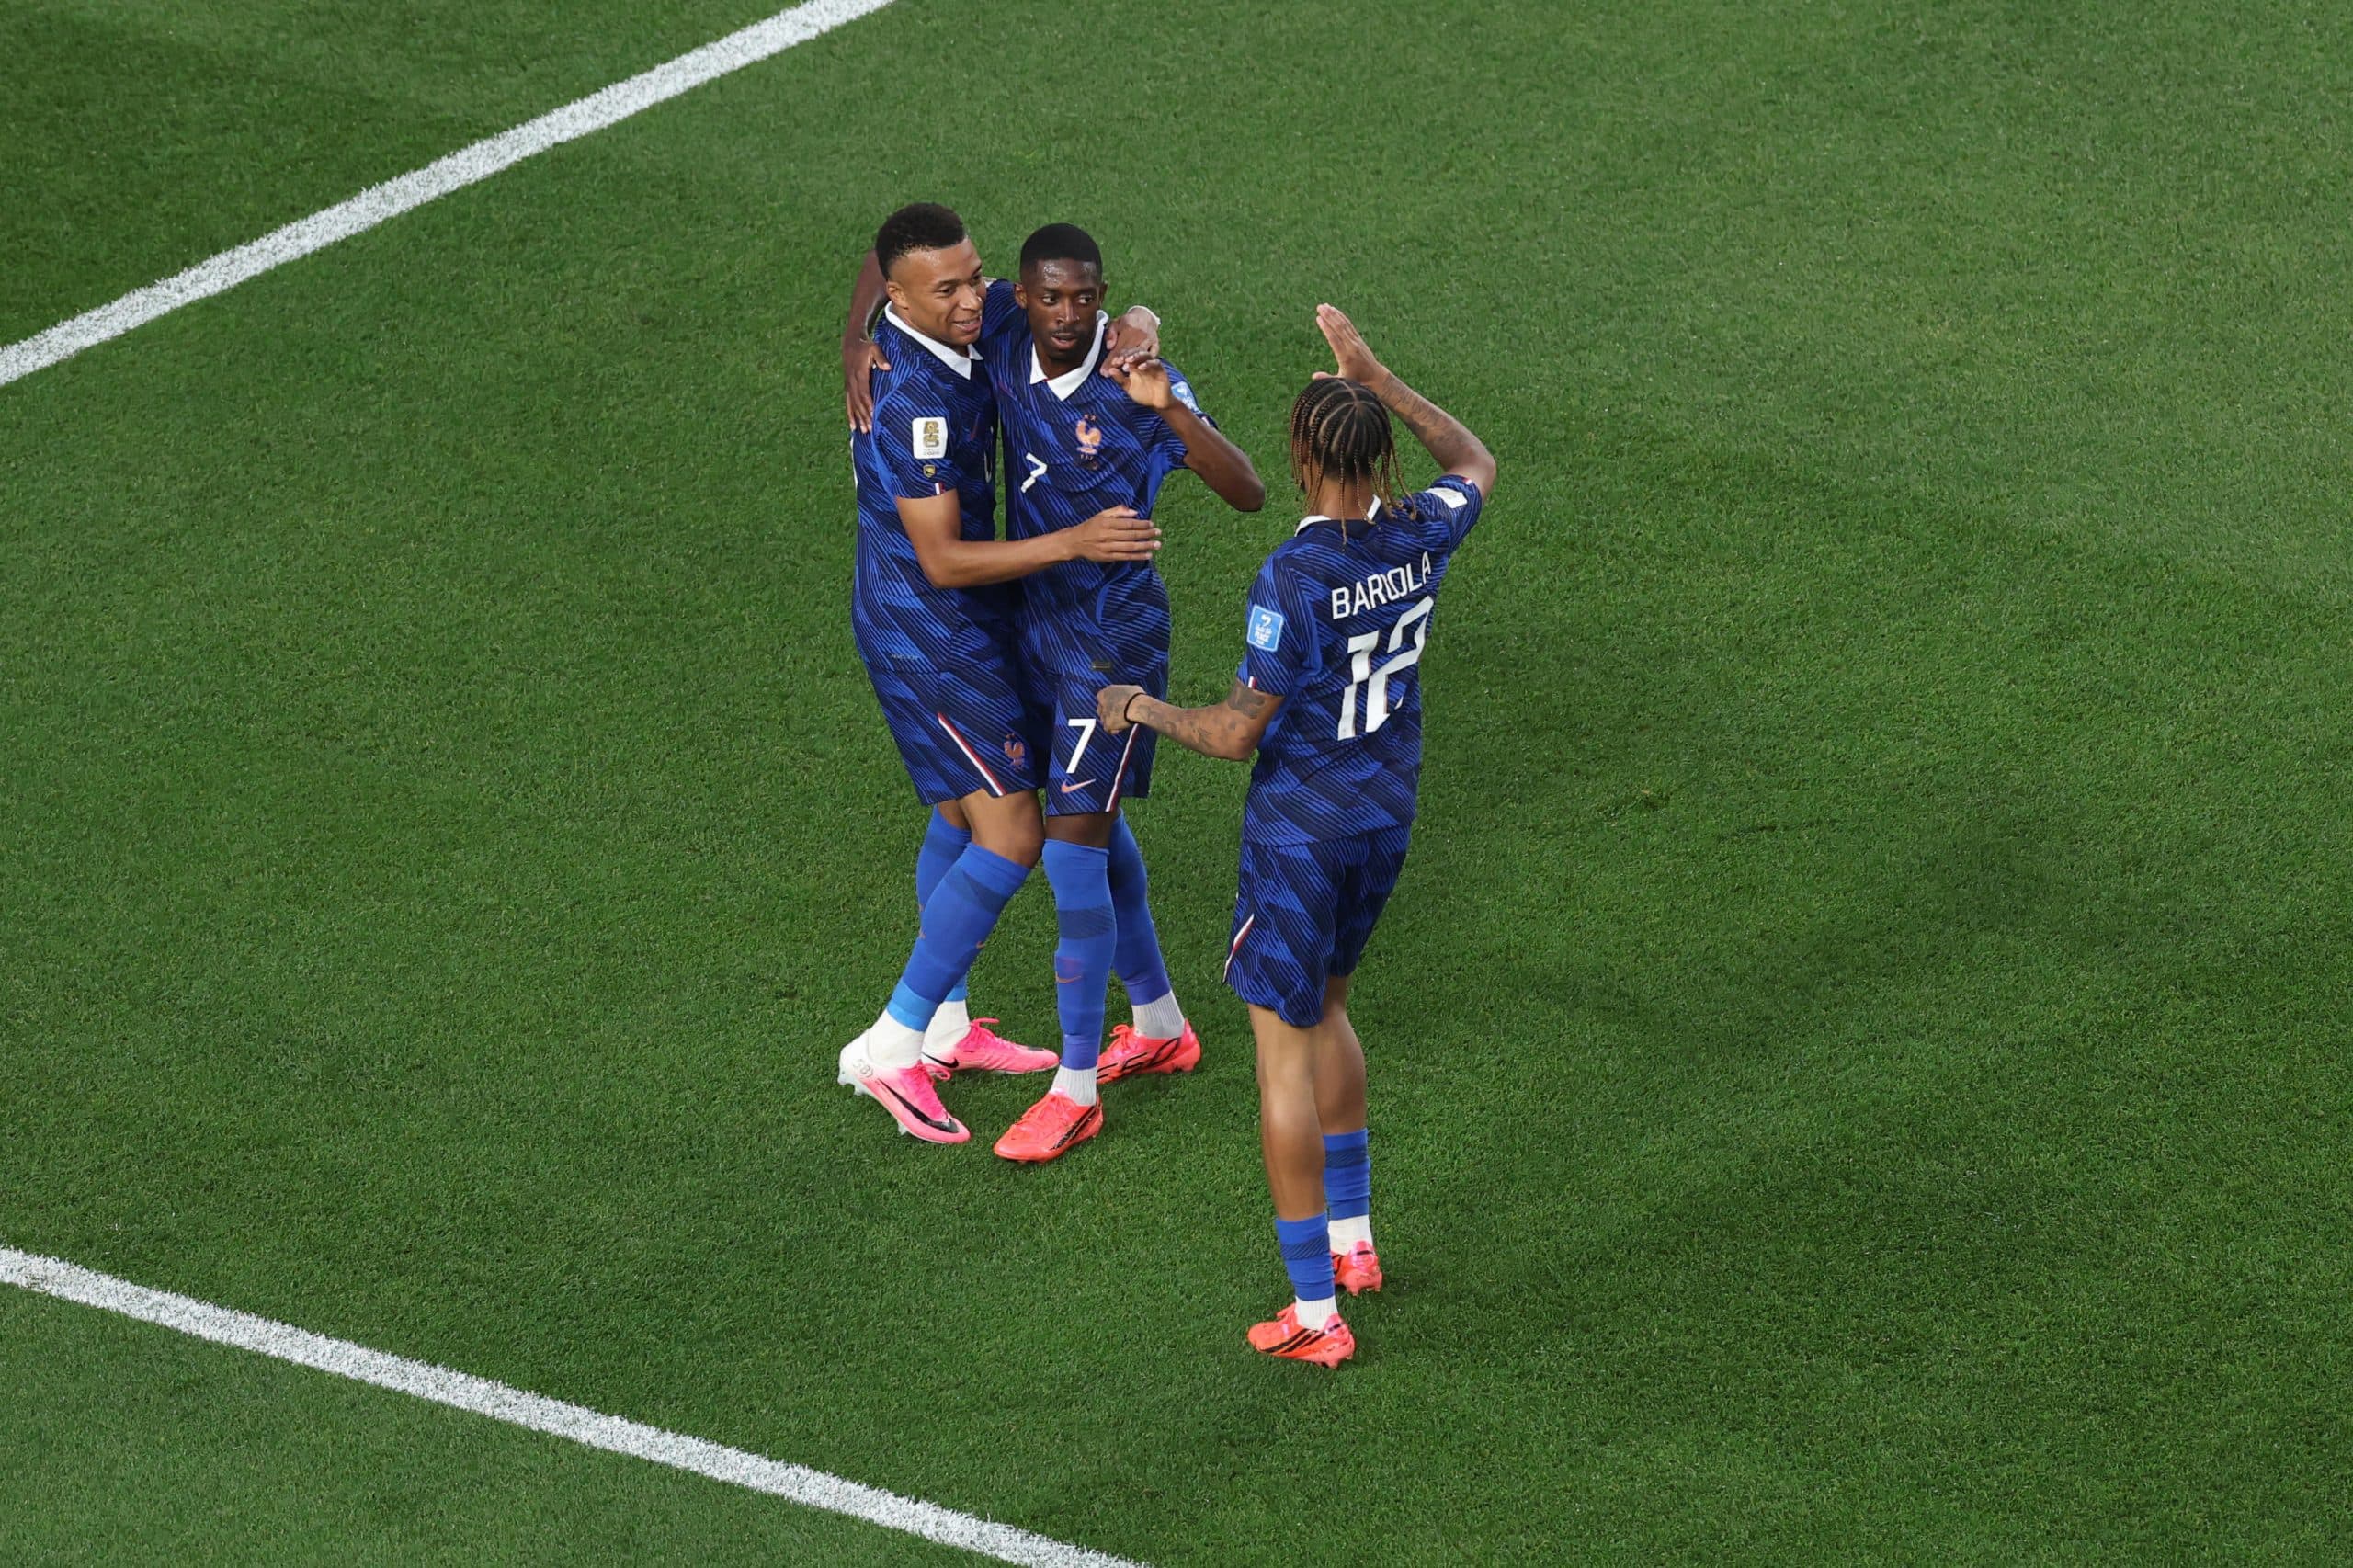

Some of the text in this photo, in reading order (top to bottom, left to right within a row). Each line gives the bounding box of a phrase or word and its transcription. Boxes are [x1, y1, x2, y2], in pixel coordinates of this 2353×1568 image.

[1021, 452, 1047, 493] 7
[1337, 595, 1434, 741] 12
[1067, 719, 1096, 773] 7
